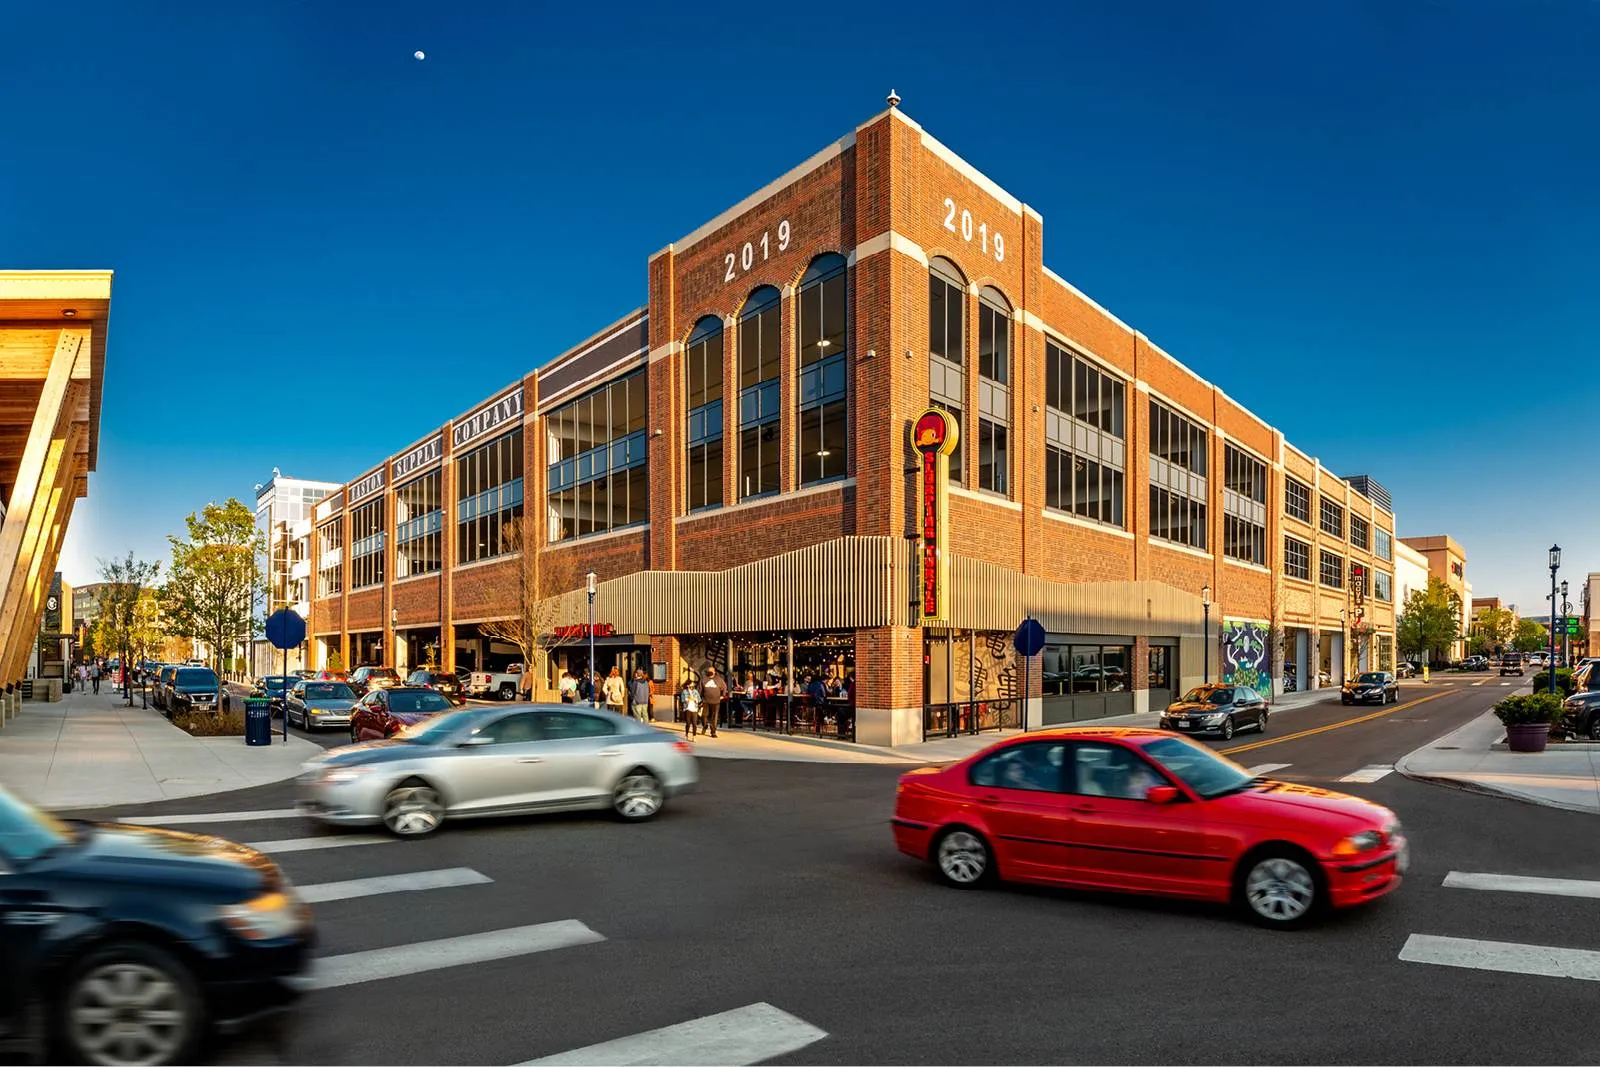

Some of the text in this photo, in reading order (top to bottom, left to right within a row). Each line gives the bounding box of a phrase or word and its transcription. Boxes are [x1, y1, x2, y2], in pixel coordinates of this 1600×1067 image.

[724, 220, 791, 282] 2019
[943, 197, 1005, 263] 2019
[351, 391, 523, 501] EASTON SUPPLY COMPANY
